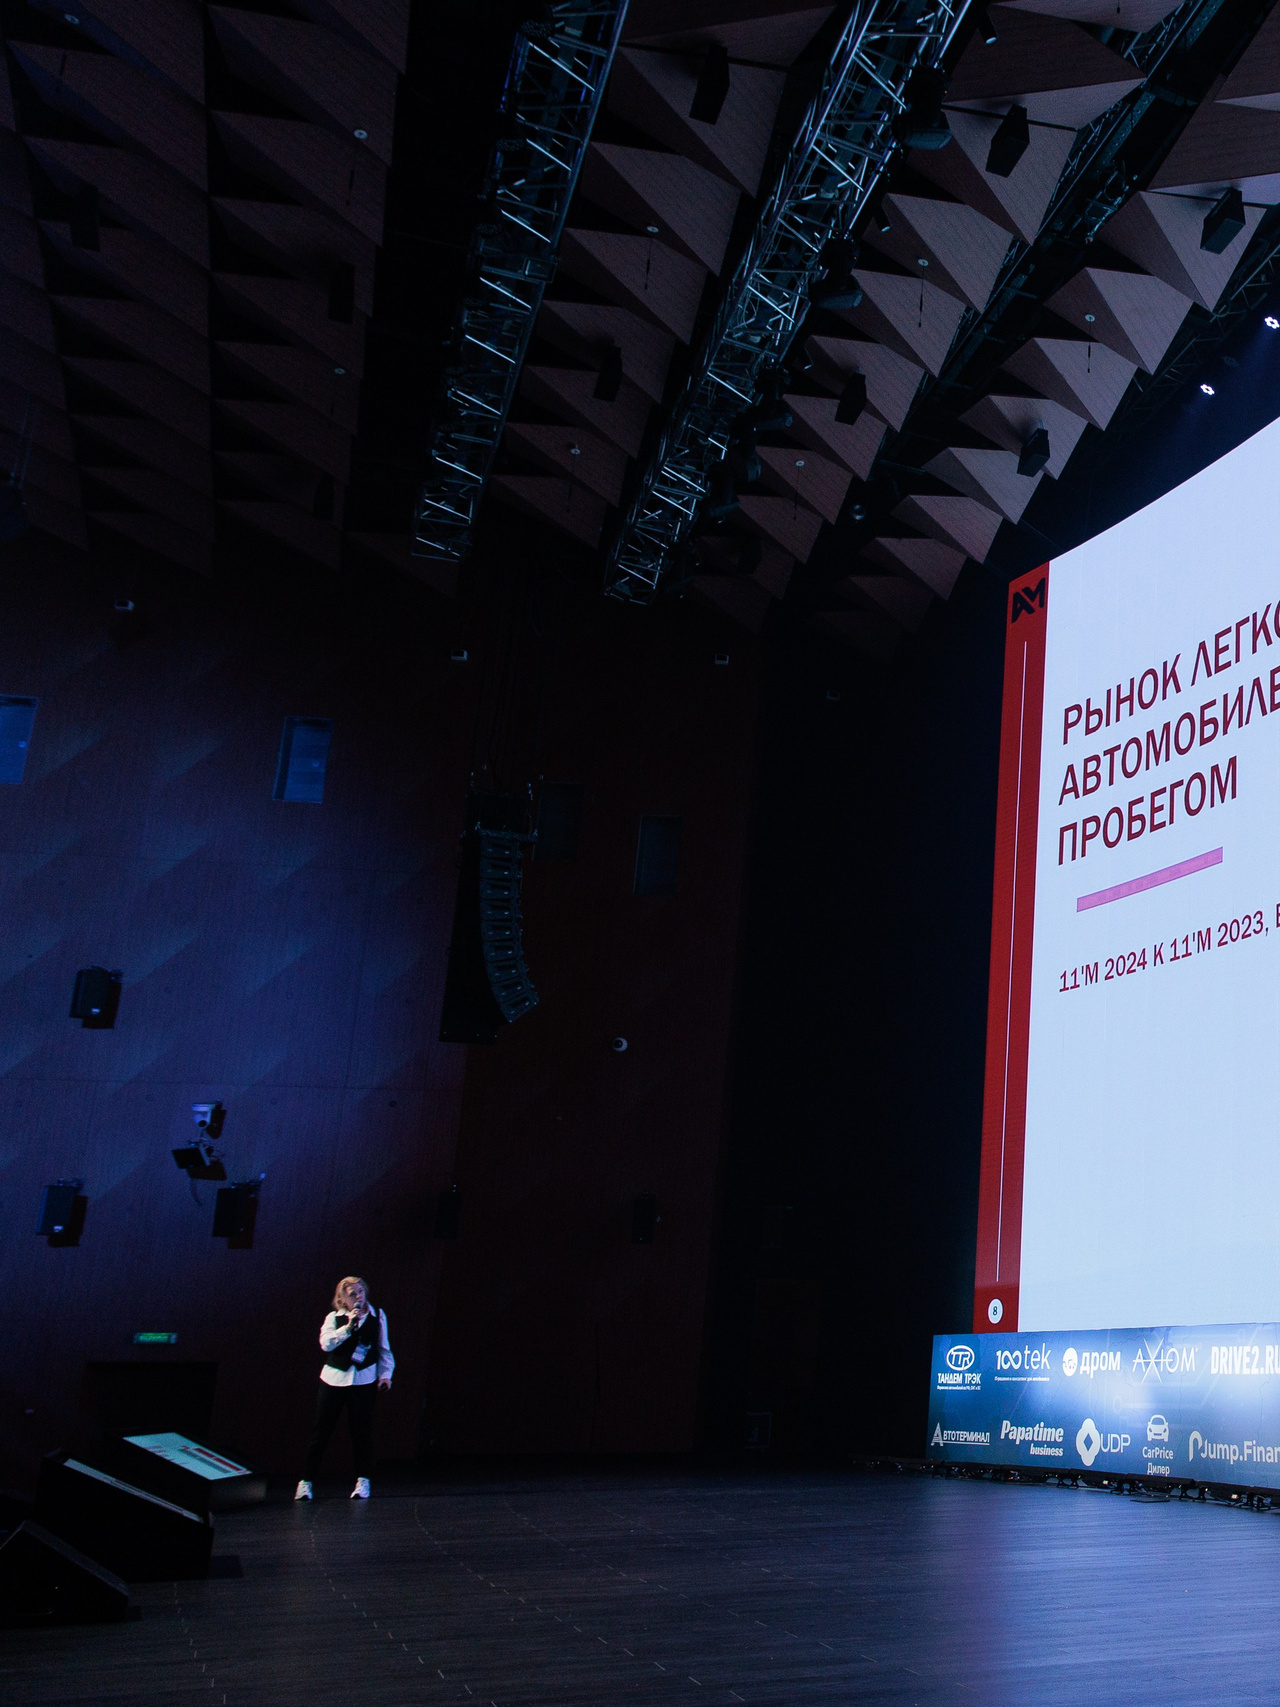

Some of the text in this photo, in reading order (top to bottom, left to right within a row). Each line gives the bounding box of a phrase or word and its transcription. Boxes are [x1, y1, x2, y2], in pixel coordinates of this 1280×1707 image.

[1062, 653, 1181, 746] РЫНОК
[1058, 755, 1238, 866] ПРОБЕГОМ
[1059, 961, 1099, 992] 11'М
[1104, 947, 1147, 980] 2024
[1153, 942, 1164, 967] К
[1169, 927, 1211, 962] 11'М
[1217, 910, 1269, 947] 2023,
[1080, 1351, 1121, 1378] дром
[937, 1373, 963, 1384] ТАНДЕМ
[964, 1373, 982, 1384] ТРЭК
[1000, 1420, 1064, 1447] Papatime
[1100, 1433, 1131, 1453] UDP
[1030, 1442, 1064, 1457] business
[1142, 1446, 1174, 1460] CarPrice
[1147, 1462, 1170, 1477] Дилер
